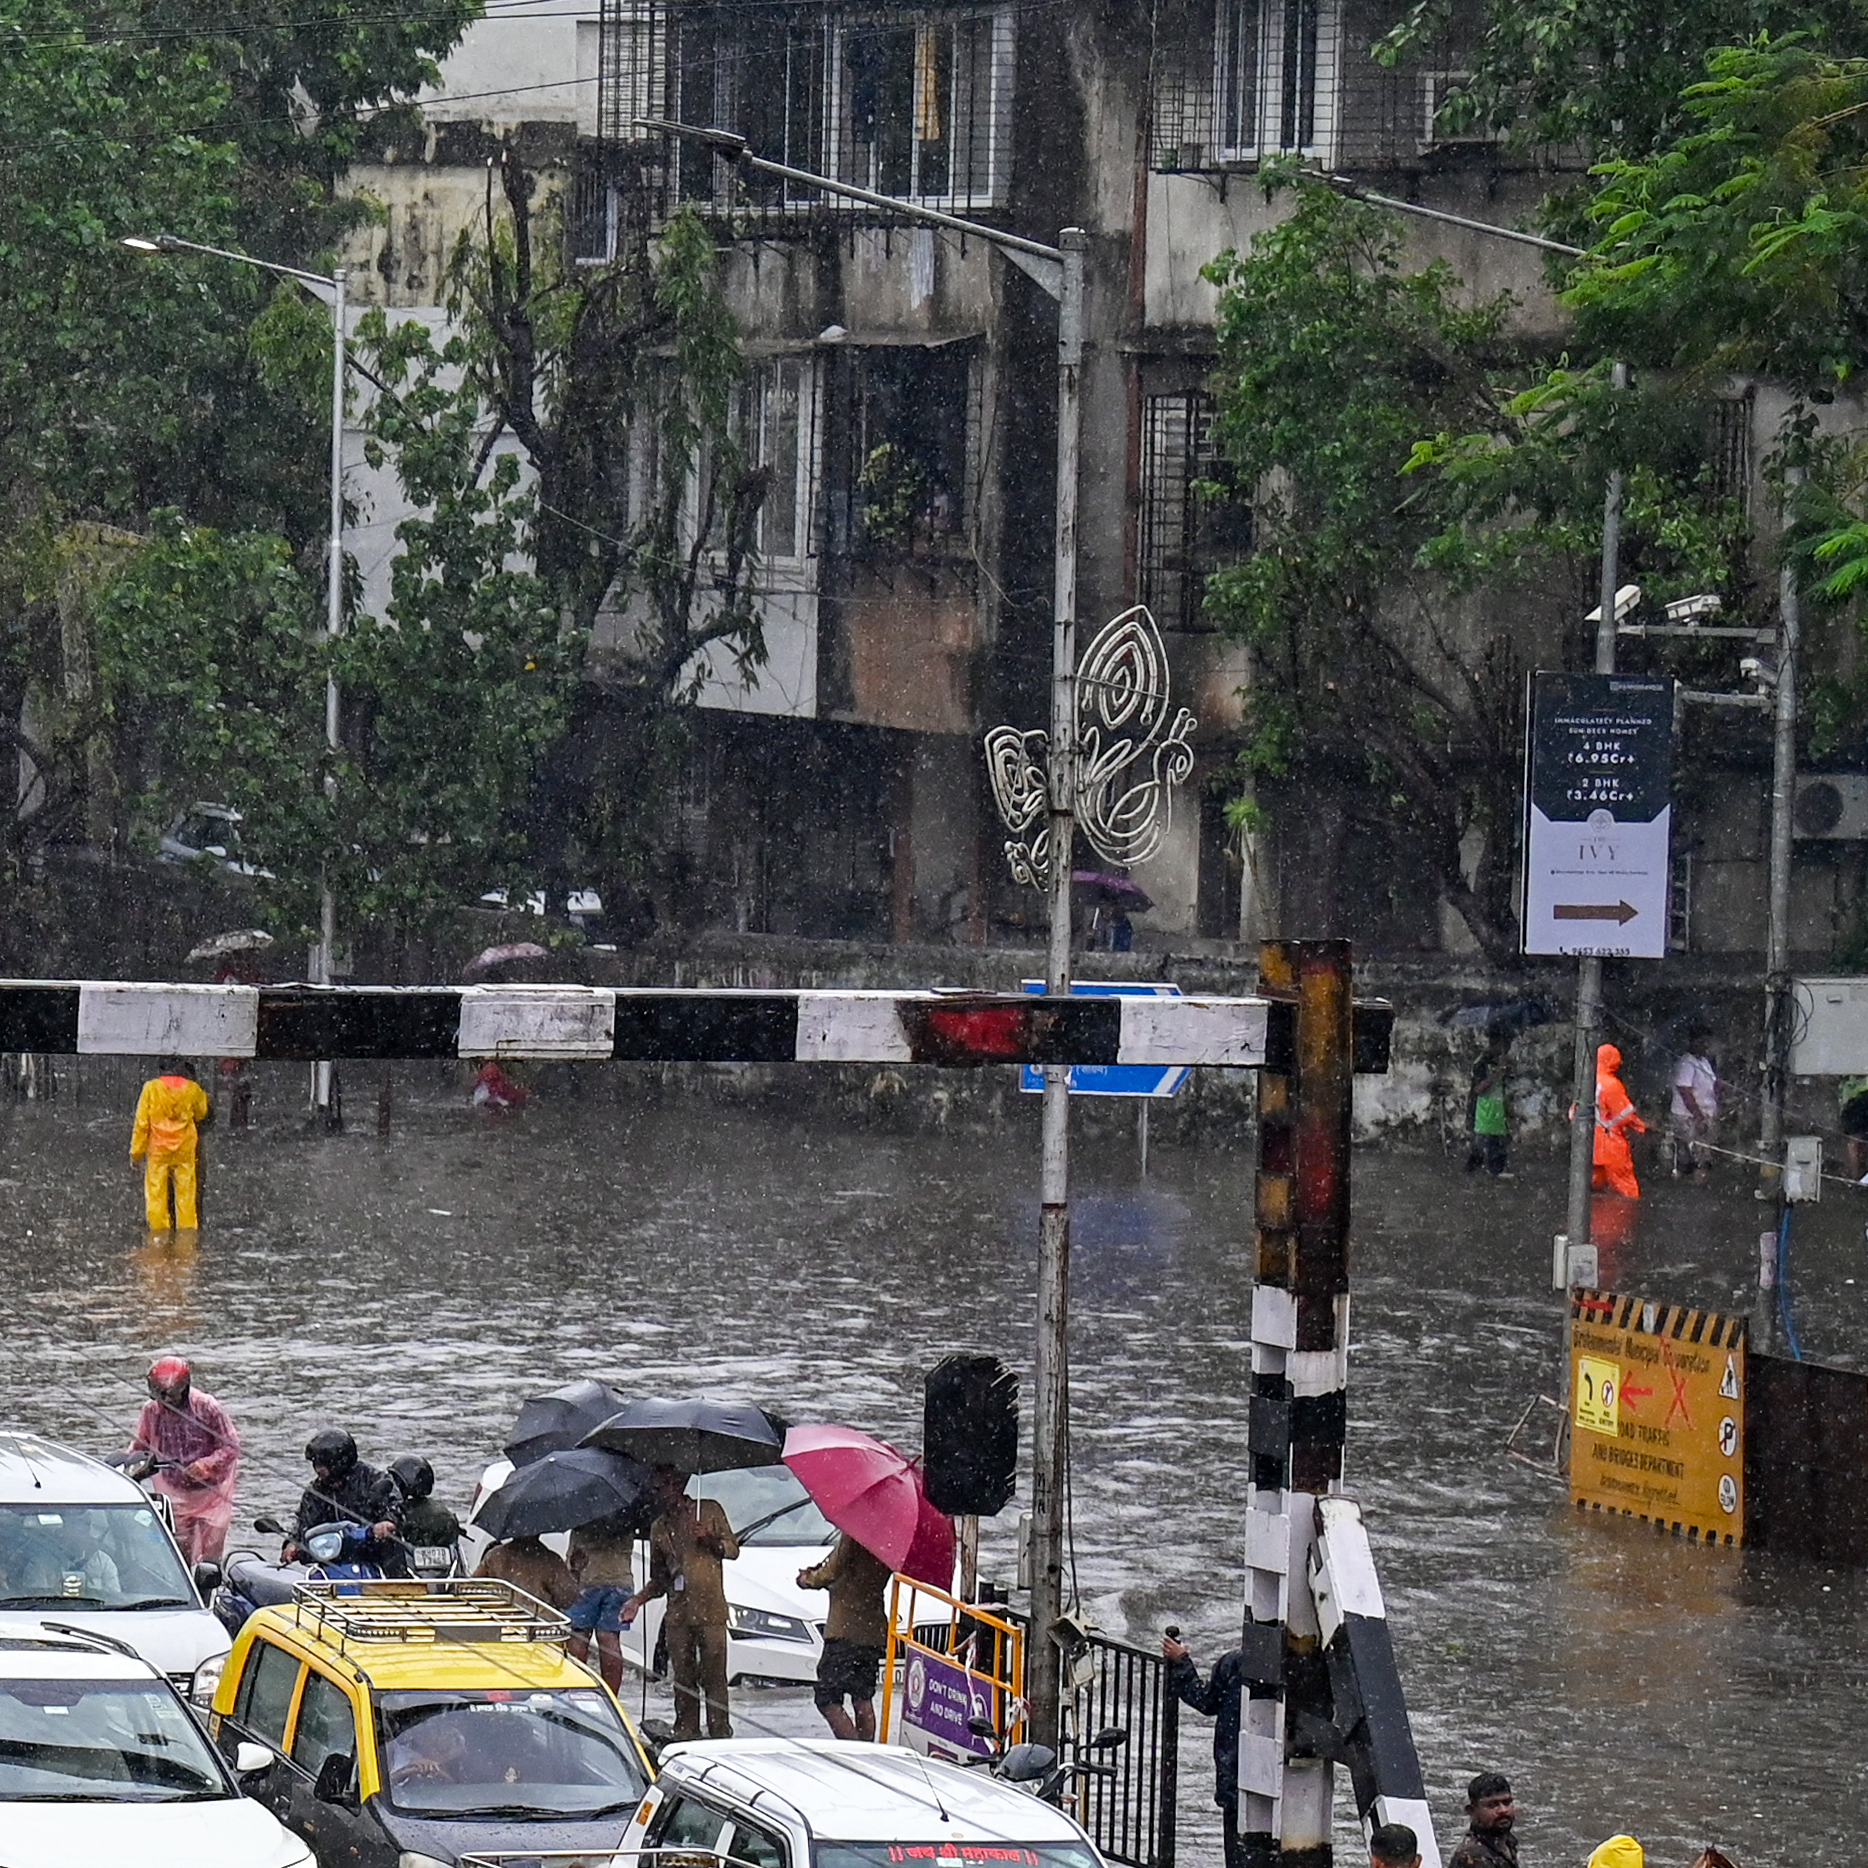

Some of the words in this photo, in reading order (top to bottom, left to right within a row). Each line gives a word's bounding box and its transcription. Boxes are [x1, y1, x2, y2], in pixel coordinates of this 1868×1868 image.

[1583, 742, 1590, 751] 4
[1594, 742, 1621, 751] BHK
[1582, 778, 1589, 787] 2
[1594, 778, 1620, 788] BHK
[1579, 845, 1620, 861] IVY
[930, 1701, 945, 1715] AND
[945, 1705, 963, 1725] DRIVE
